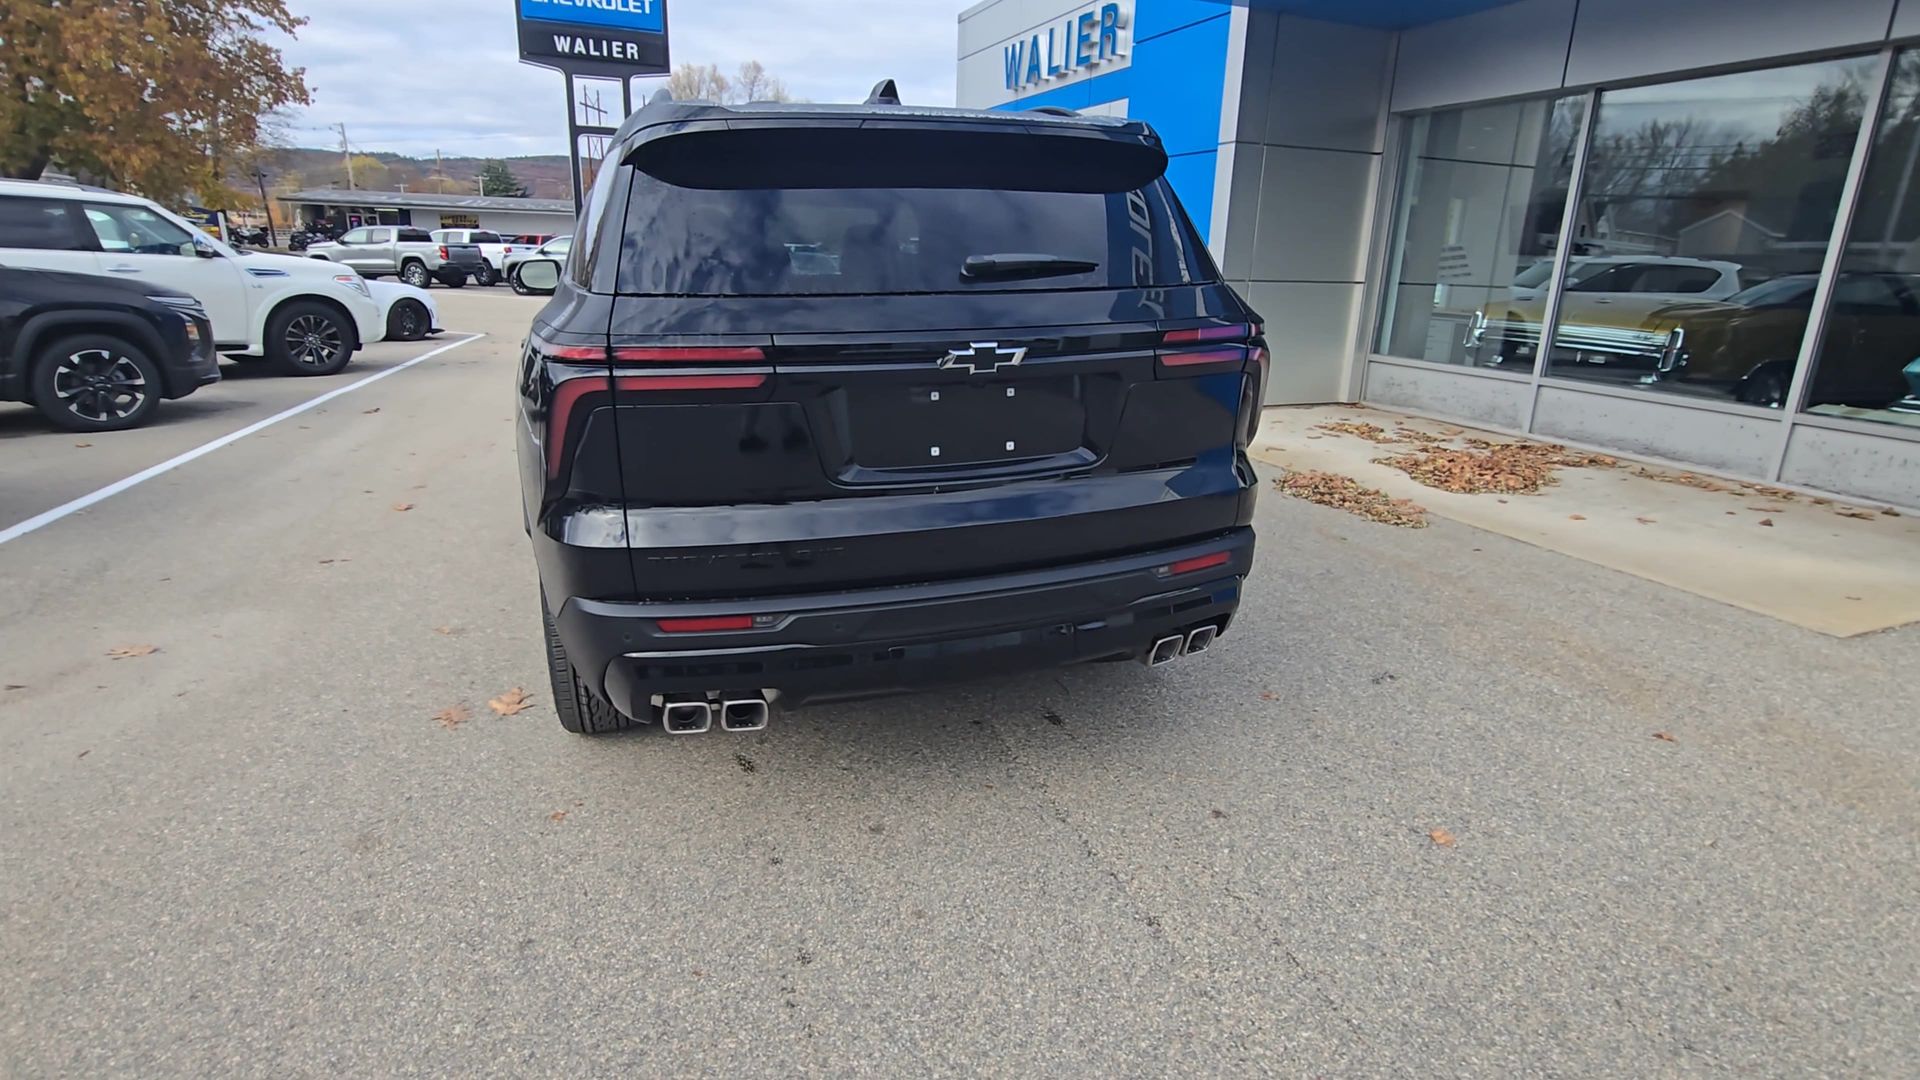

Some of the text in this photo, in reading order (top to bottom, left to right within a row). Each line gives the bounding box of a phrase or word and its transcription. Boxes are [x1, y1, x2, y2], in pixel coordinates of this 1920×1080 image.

[531, 0, 653, 14] ROLET
[553, 34, 640, 60] WALIER
[1004, 2, 1121, 90] WALIER
